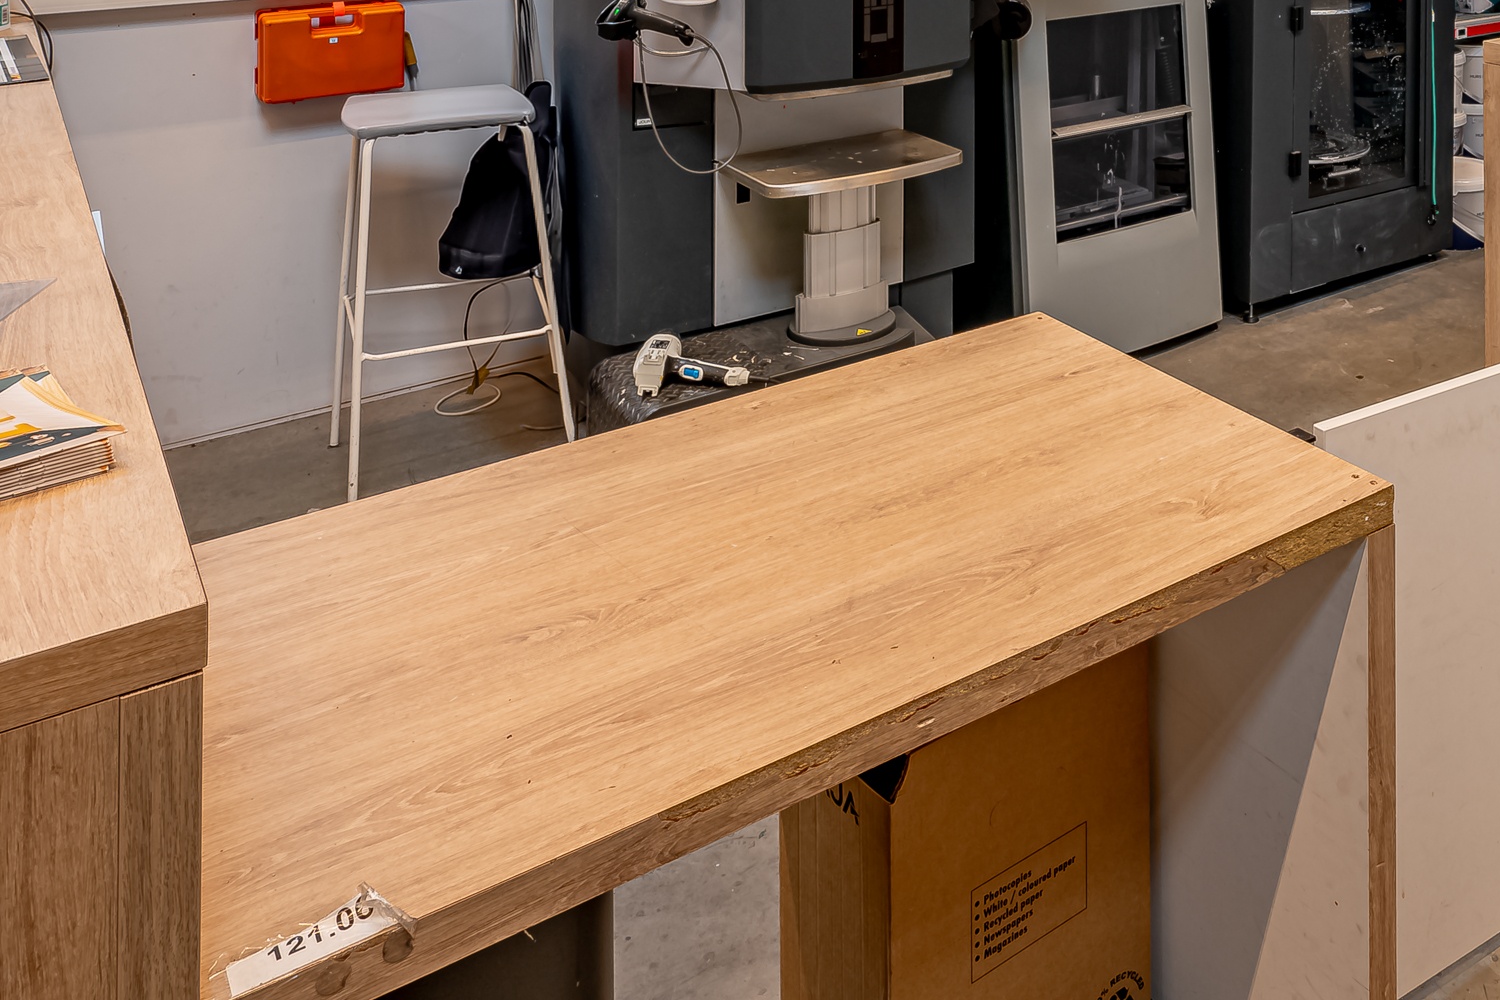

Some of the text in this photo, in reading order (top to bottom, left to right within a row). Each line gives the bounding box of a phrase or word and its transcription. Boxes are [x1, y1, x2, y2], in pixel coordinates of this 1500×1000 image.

[983, 898, 1008, 918] White
[1018, 872, 1052, 898] coloured
[1054, 855, 1076, 878] paper
[983, 869, 1032, 905] Photocopies
[983, 888, 1045, 932] Recycled paper
[983, 908, 1034, 946] Newspapers
[983, 924, 1028, 960] Magazines
[1109, 970, 1145, 991] RECYCLED
